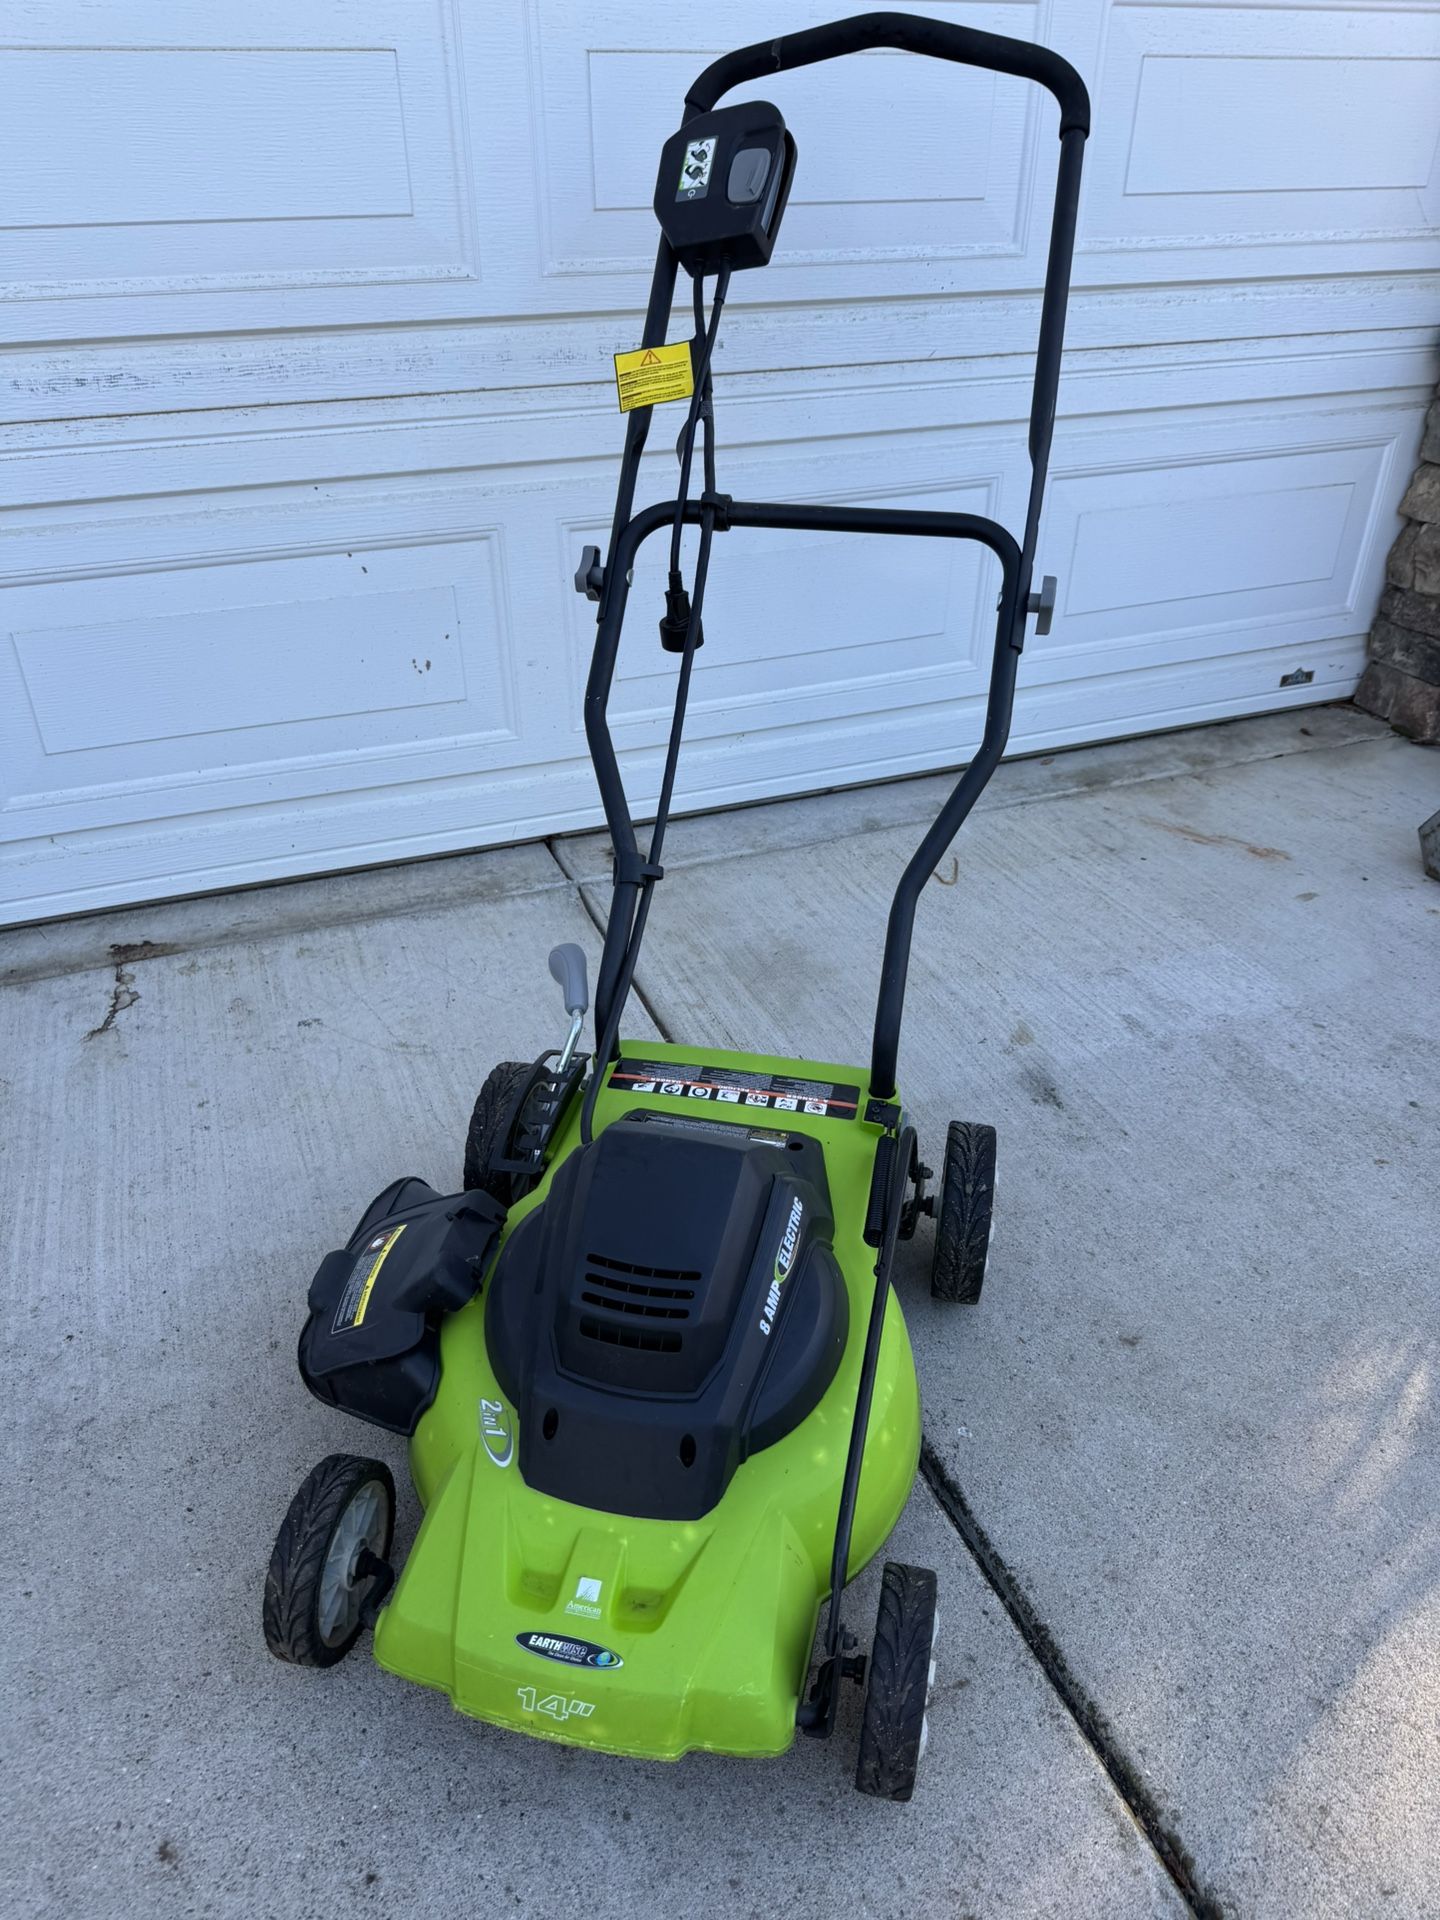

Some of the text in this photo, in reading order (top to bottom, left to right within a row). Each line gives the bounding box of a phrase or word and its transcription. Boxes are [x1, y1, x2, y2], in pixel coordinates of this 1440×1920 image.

[759, 1196, 804, 1336] 8 AMP ELECTRIC
[566, 1600, 602, 1616] American
